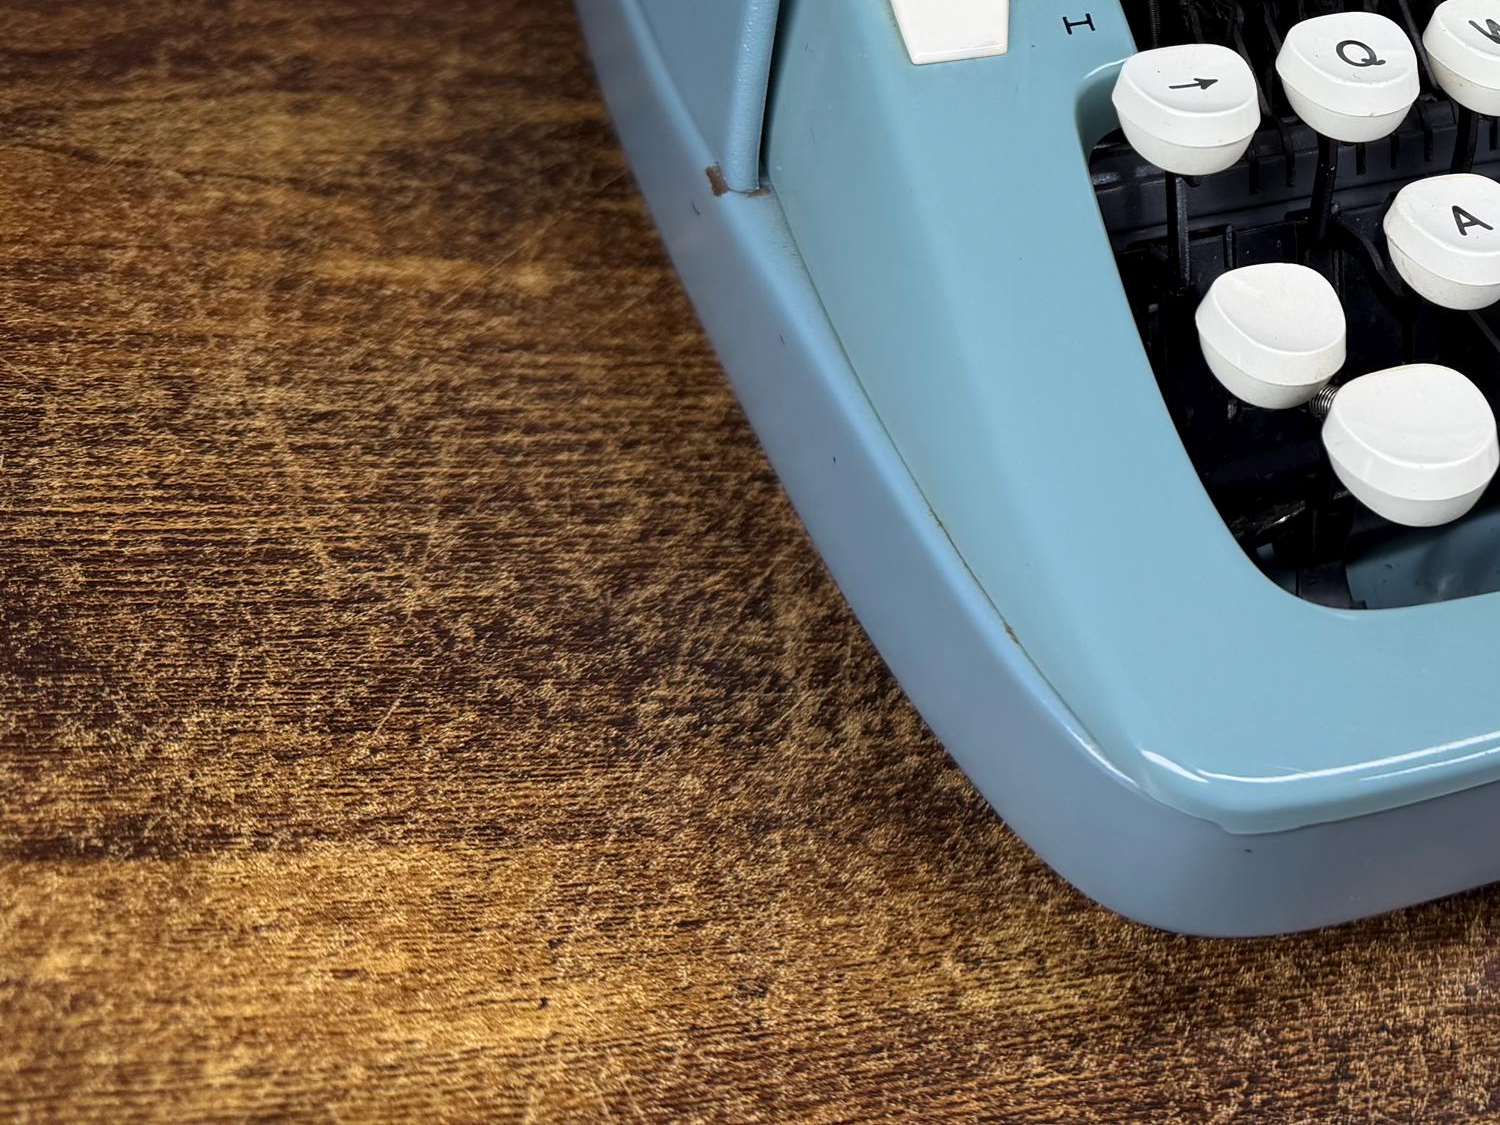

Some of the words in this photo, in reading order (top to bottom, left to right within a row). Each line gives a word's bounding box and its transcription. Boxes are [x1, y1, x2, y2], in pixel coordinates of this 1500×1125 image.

[1062, 13, 1095, 35] H
[1336, 40, 1386, 67] Q
[1452, 205, 1494, 236] A
